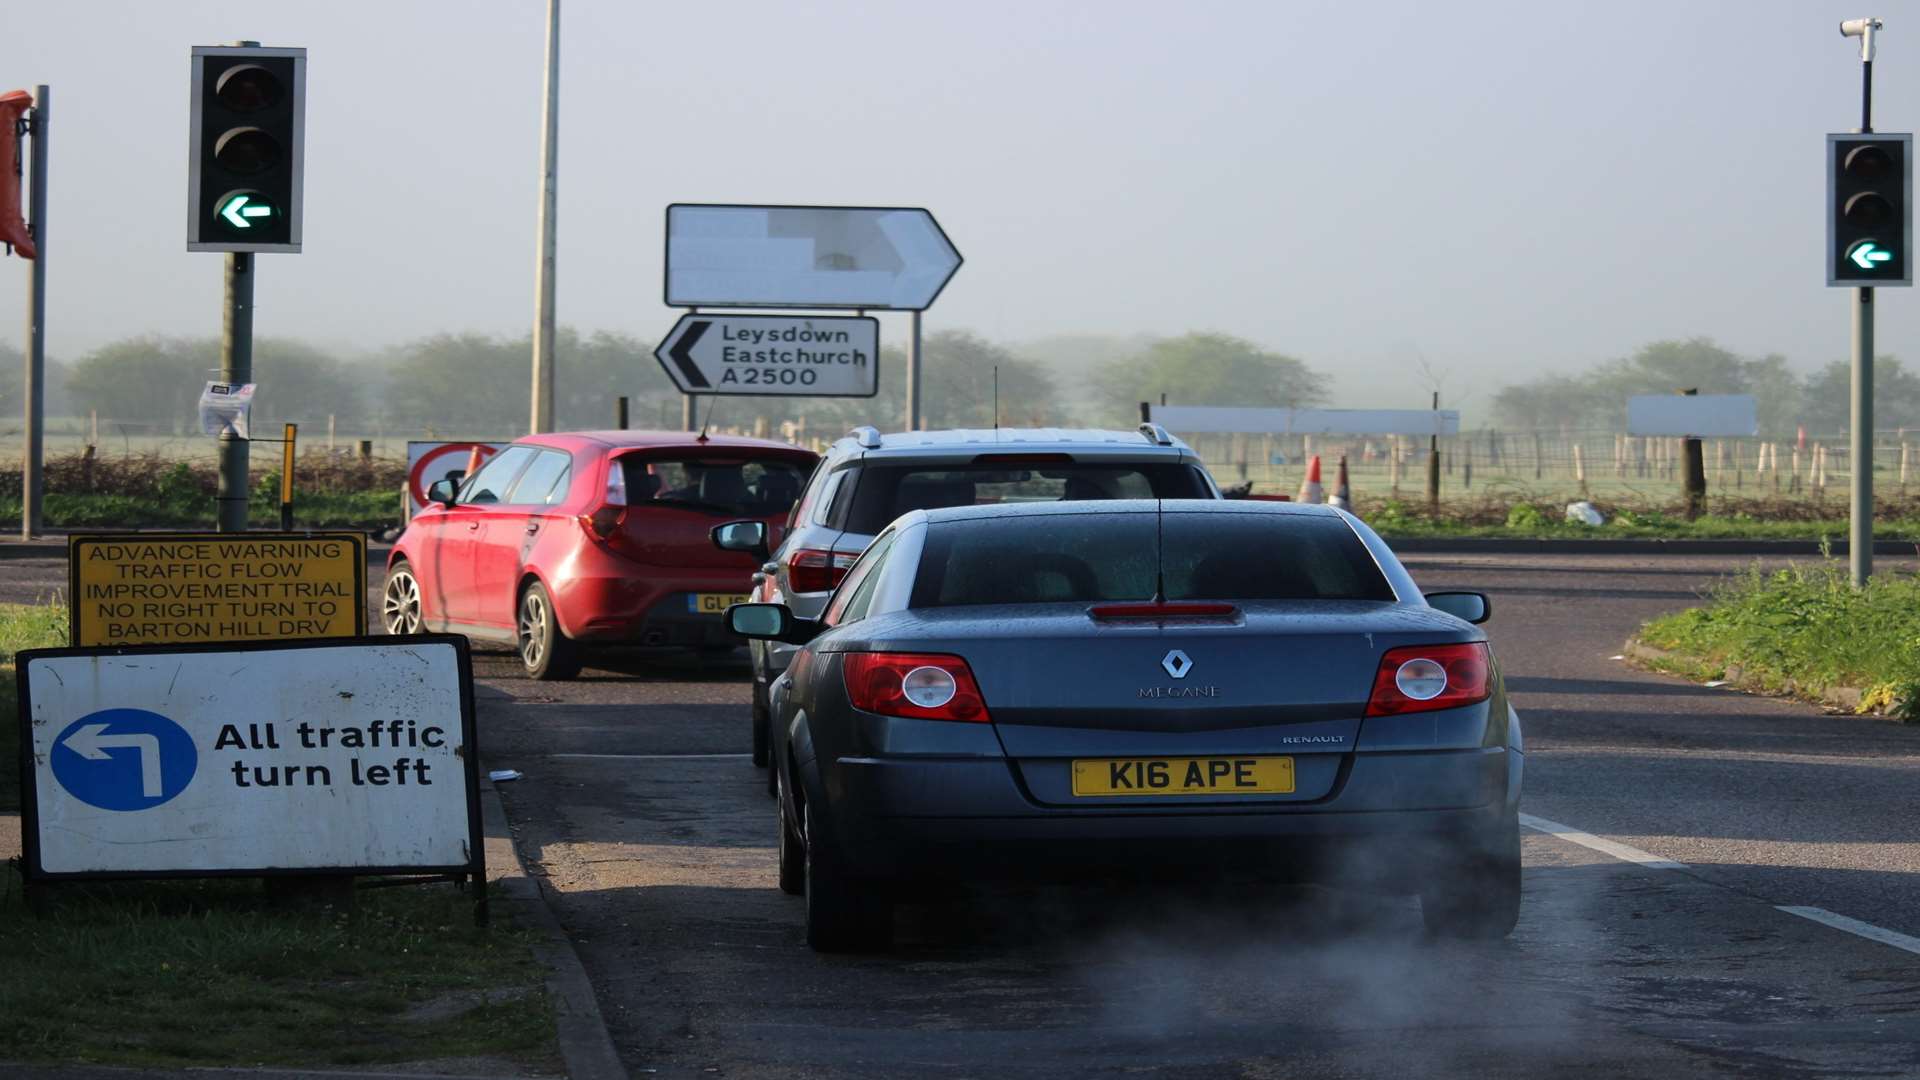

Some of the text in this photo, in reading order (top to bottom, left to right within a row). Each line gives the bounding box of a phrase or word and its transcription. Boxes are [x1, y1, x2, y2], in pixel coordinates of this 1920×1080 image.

[722, 325, 849, 344] Leysdown
[722, 346, 867, 367] Eastchurch
[721, 367, 817, 386] A2500
[89, 543, 341, 561] ADVANCE WARNING
[115, 563, 303, 579] TRAFFIC FLOW
[86, 582, 350, 599] IMPROVEMENT TRIAL
[98, 601, 337, 618] NO RIGHT TURN TO
[108, 620, 331, 638] BARTON HILL DRV
[1137, 686, 1221, 699] MEGANE
[214, 719, 445, 750] All traffic
[1282, 735, 1345, 744] RENAULT
[231, 758, 432, 788] turn left
[1183, 760, 1258, 788] APE
